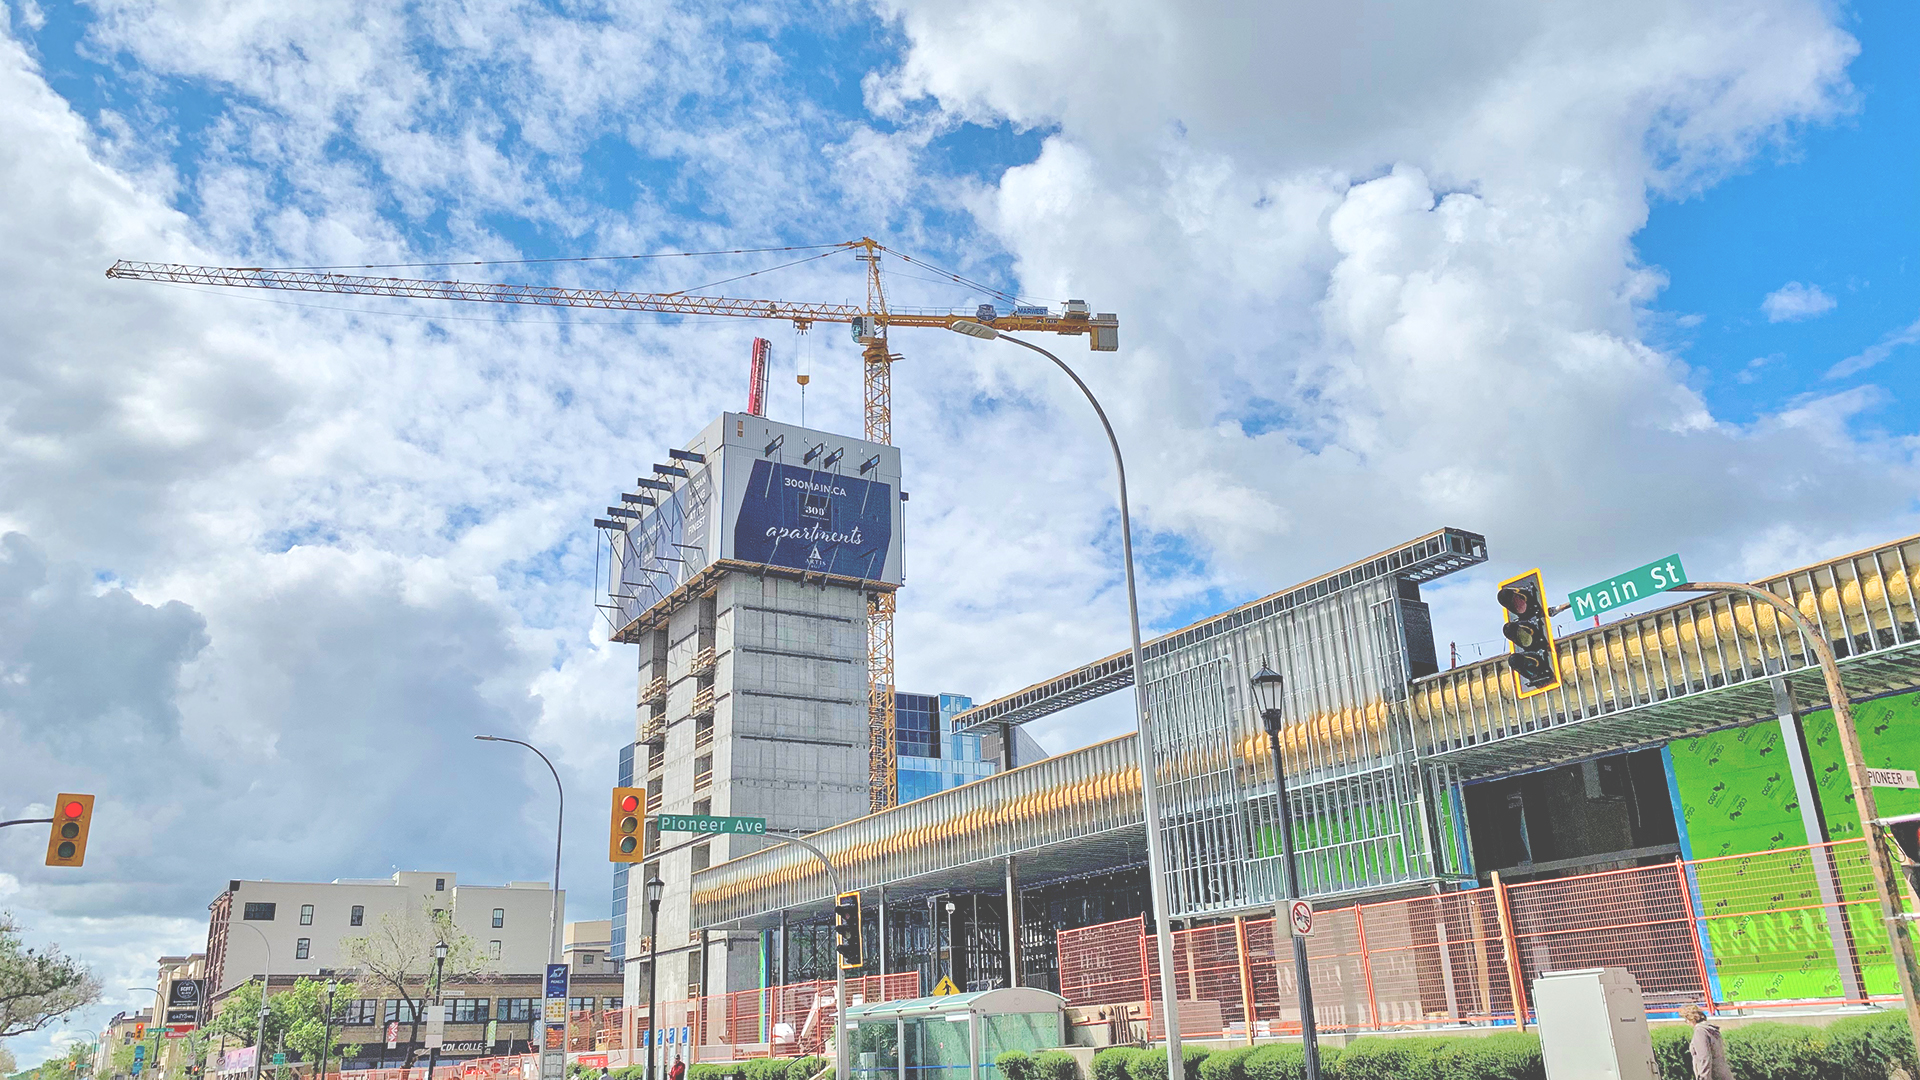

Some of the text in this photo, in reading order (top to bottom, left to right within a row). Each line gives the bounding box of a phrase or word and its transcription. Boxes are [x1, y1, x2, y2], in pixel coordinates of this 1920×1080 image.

[1017, 307, 1048, 315] MARWEST
[784, 477, 847, 497] 300MAIN.CA
[687, 515, 706, 537] FINEST
[765, 521, 864, 546] apartments
[1575, 562, 1680, 616] Main St
[1737, 728, 1748, 742] CGC
[1767, 733, 1778, 746] CGC
[1867, 770, 1904, 785] PIONEER
[1761, 783, 1773, 796] CGC
[1708, 791, 1718, 805] CGC
[661, 816, 763, 832] Pioneer Ave
[440, 1042, 488, 1052] CDI COLLE
